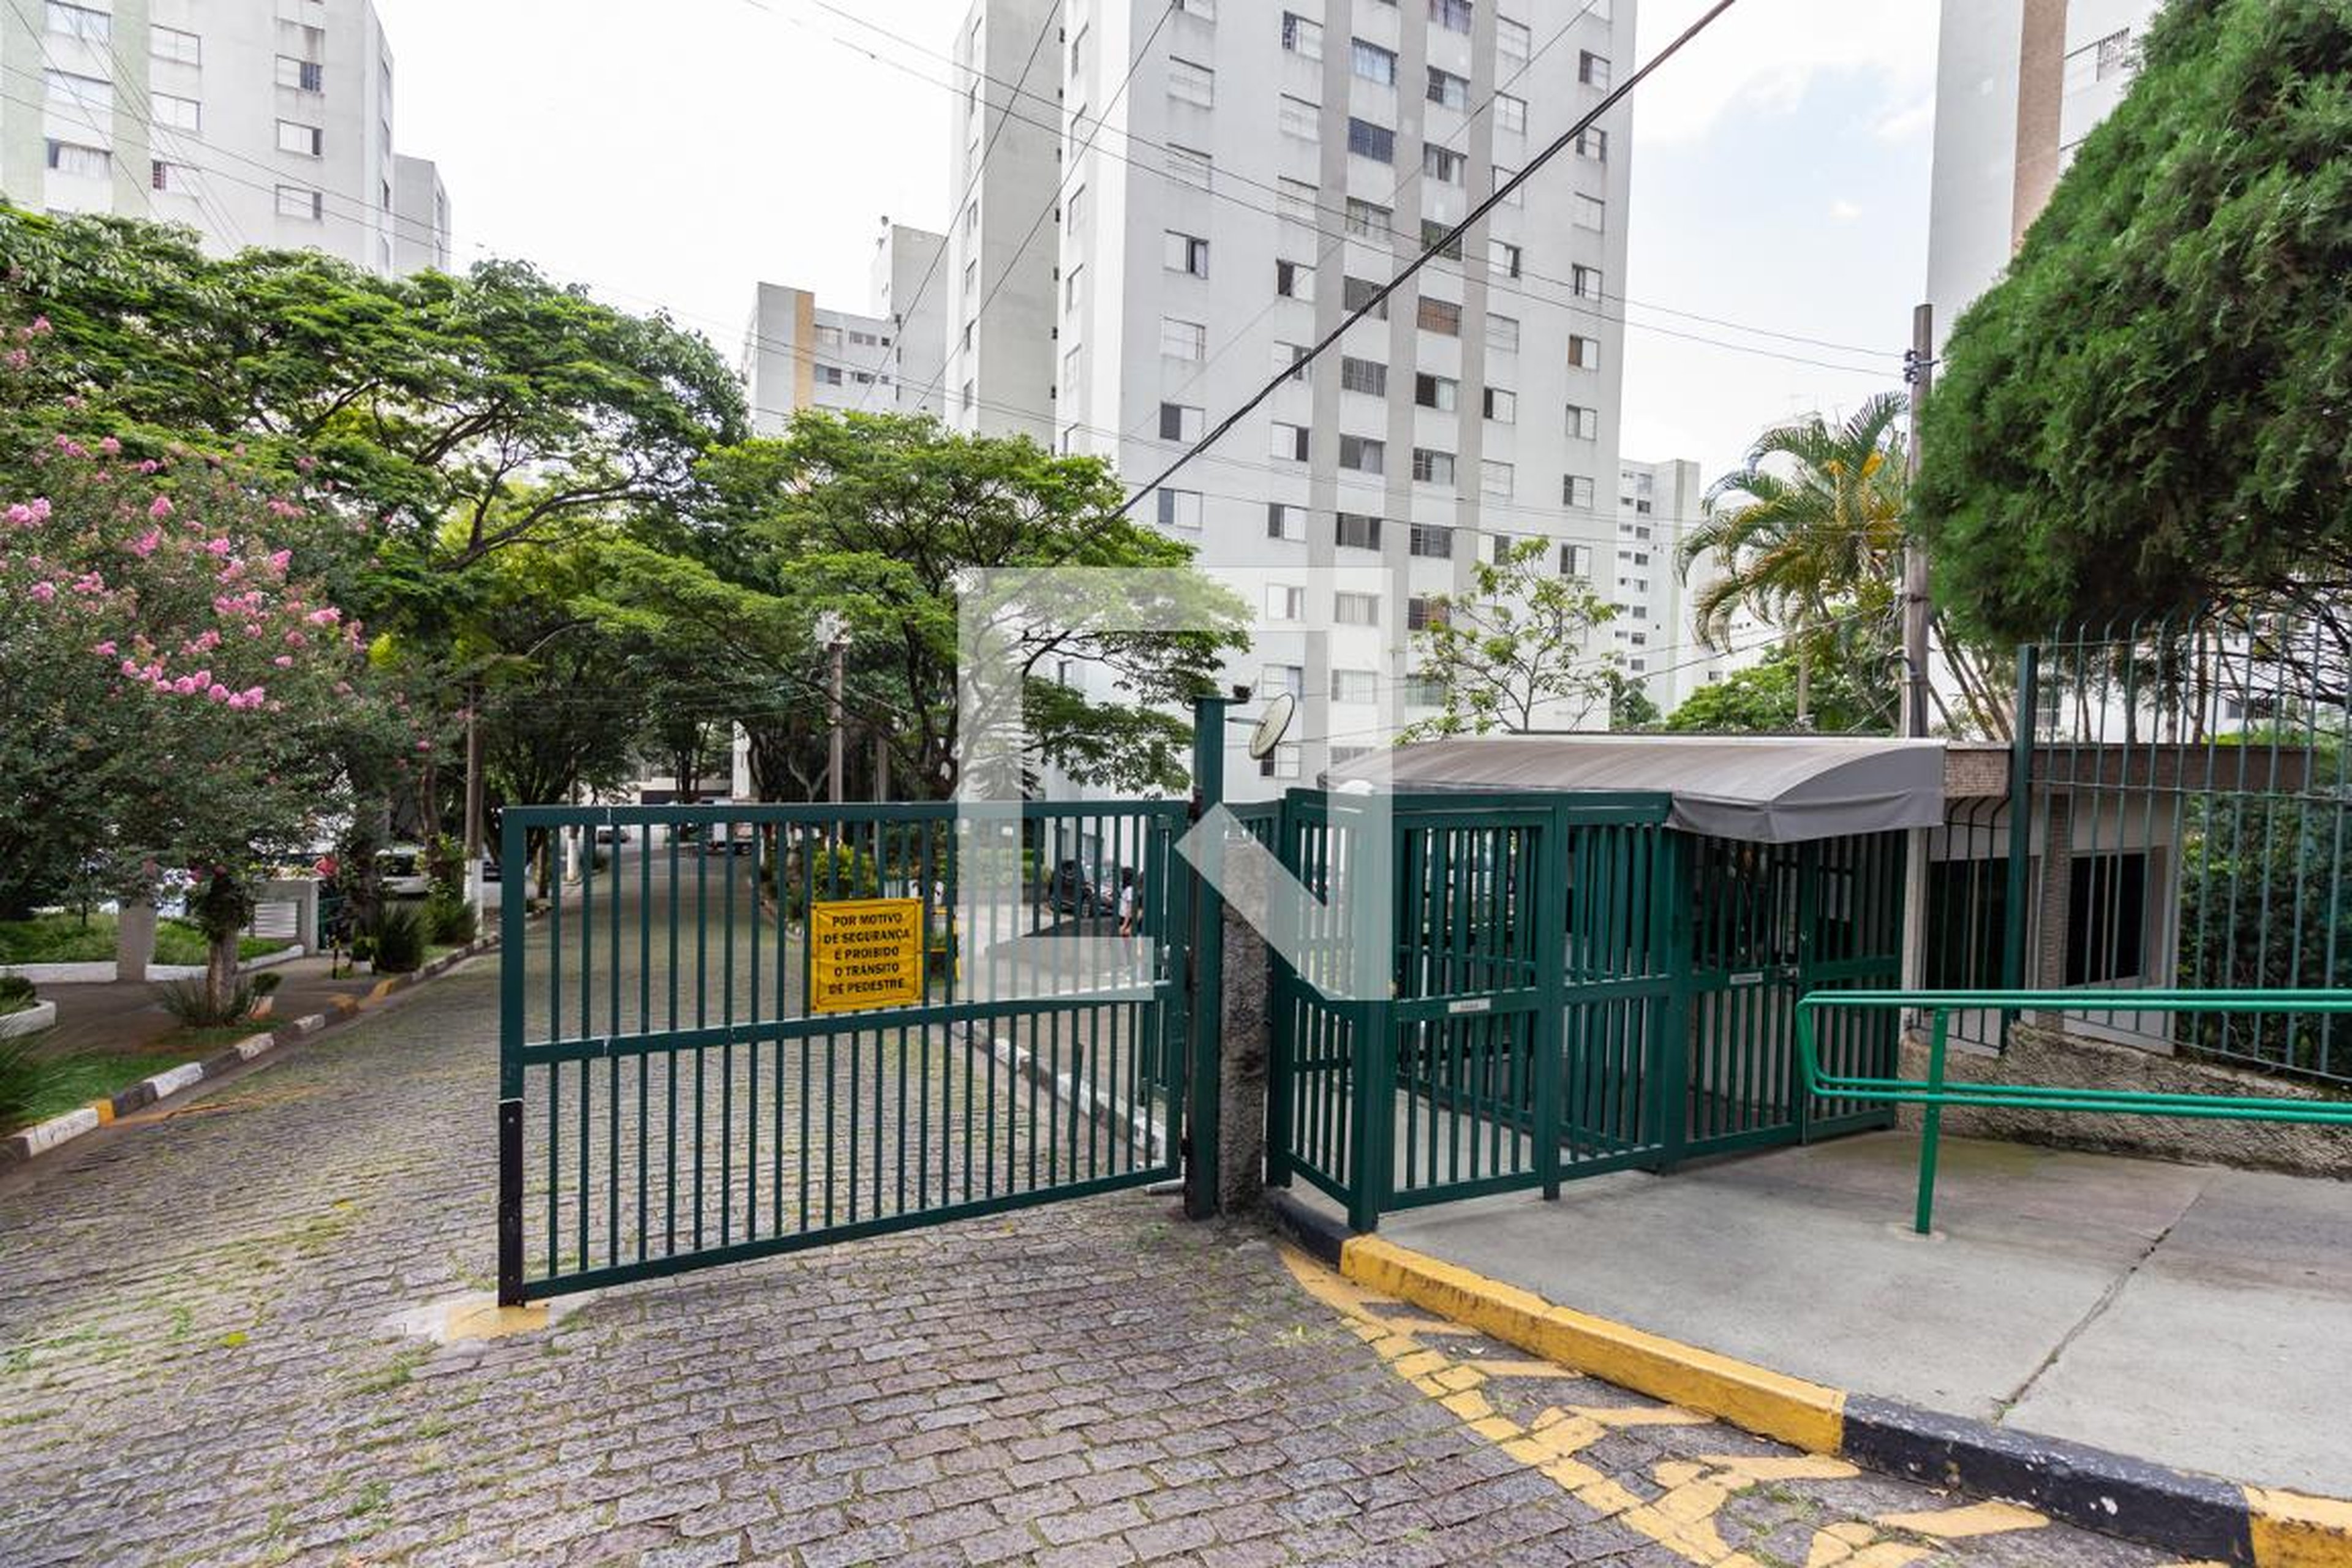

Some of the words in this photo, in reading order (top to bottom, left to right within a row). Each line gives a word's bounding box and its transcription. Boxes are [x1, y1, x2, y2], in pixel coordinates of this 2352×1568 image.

[832, 916, 856, 926] POR
[860, 913, 902, 924] MOTIVO
[824, 933, 839, 944] DE
[842, 929, 910, 942] SEGURANÇA
[845, 946, 899, 959] PROIBIDO
[834, 967, 842, 977] O
[829, 983, 843, 994] DE
[847, 978, 905, 992] PEDESTRE
